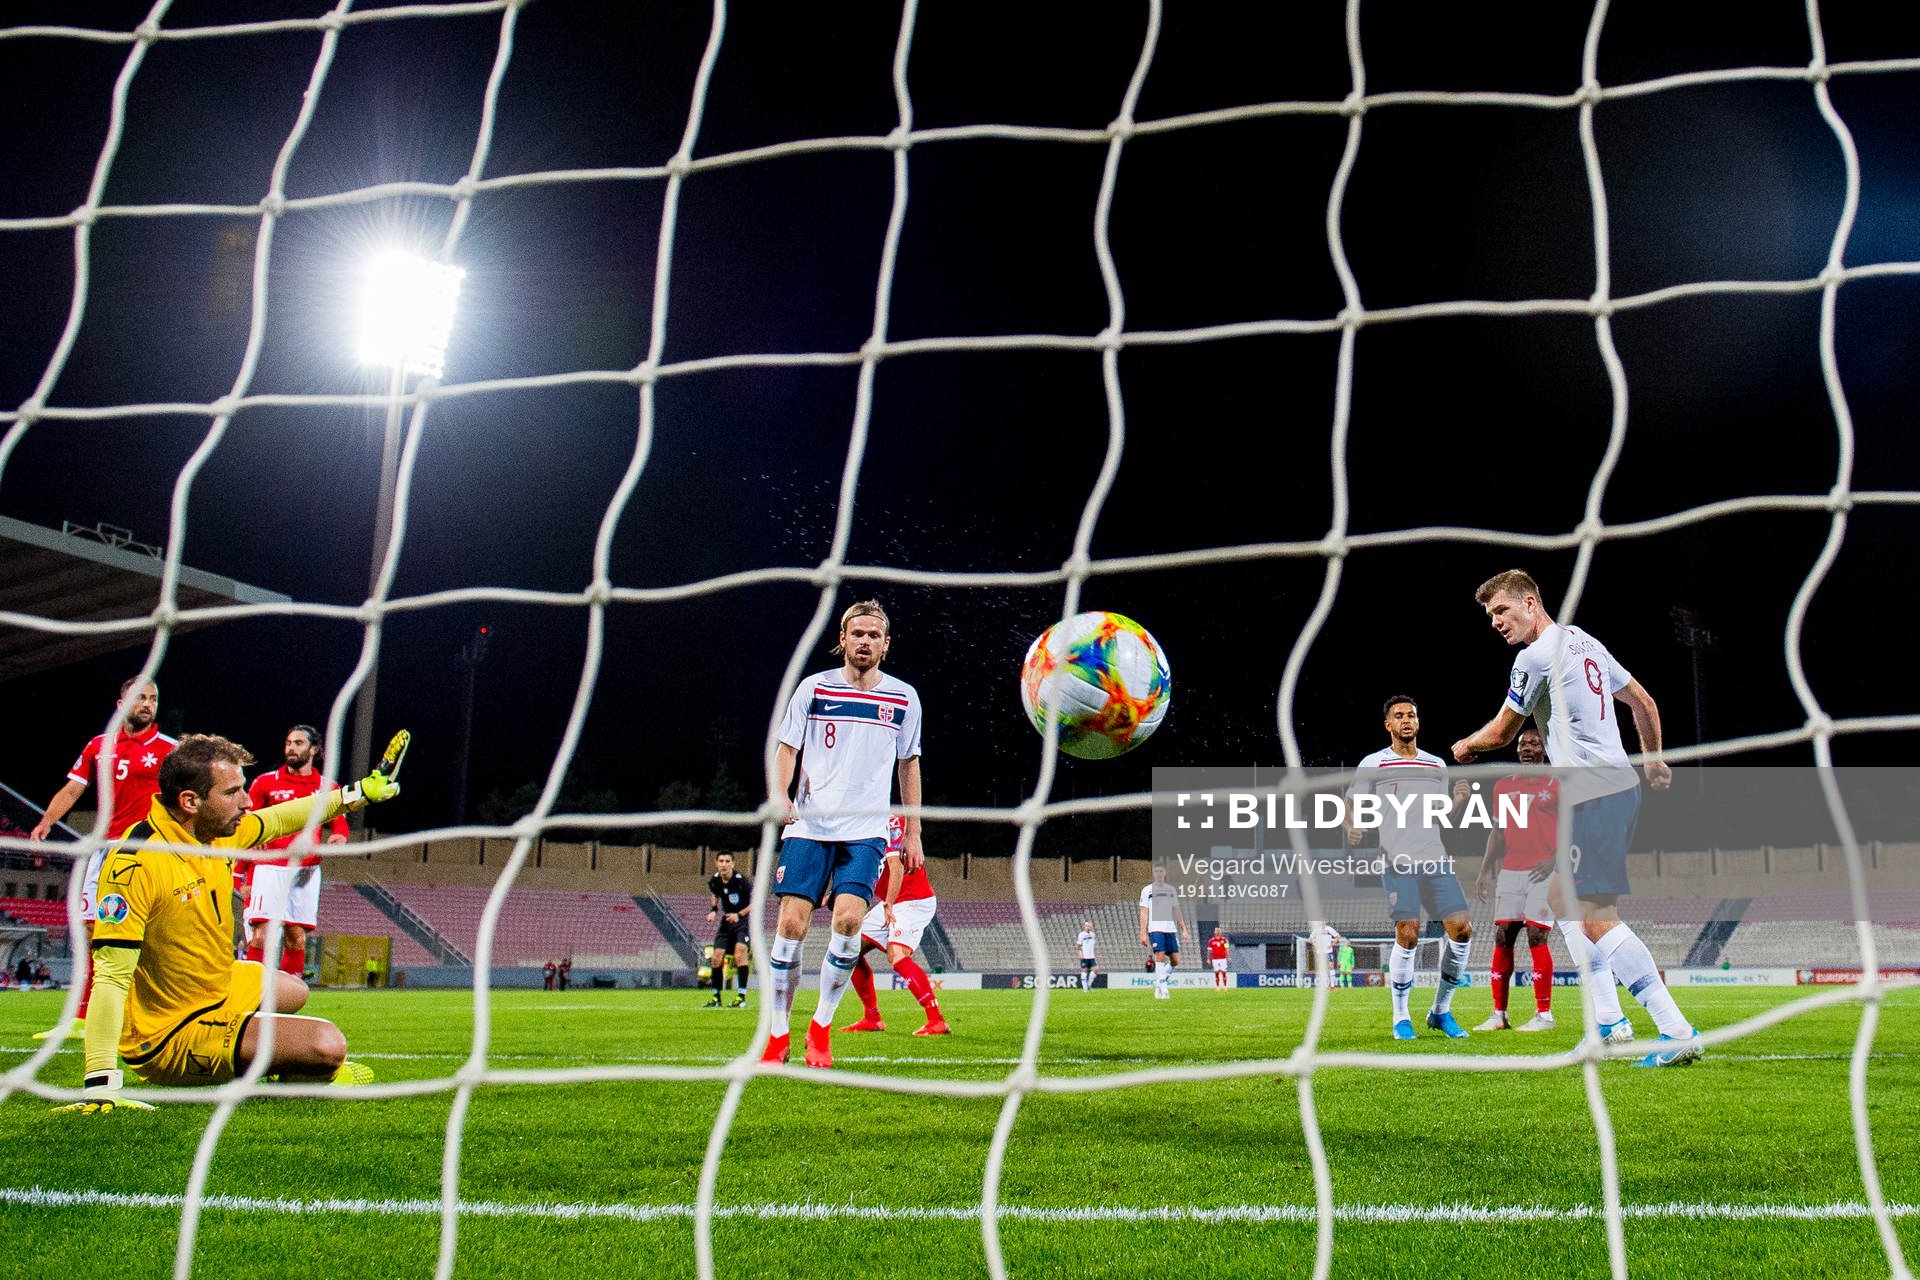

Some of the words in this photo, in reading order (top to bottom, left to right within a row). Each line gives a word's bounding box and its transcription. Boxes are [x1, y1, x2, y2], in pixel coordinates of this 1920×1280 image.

[1584, 658, 1605, 721] 9
[825, 722, 836, 749] 8
[115, 759, 131, 780] 5
[1569, 844, 1582, 874] 9
[210, 889, 222, 925] 1
[1023, 975, 1078, 989] SCAR
